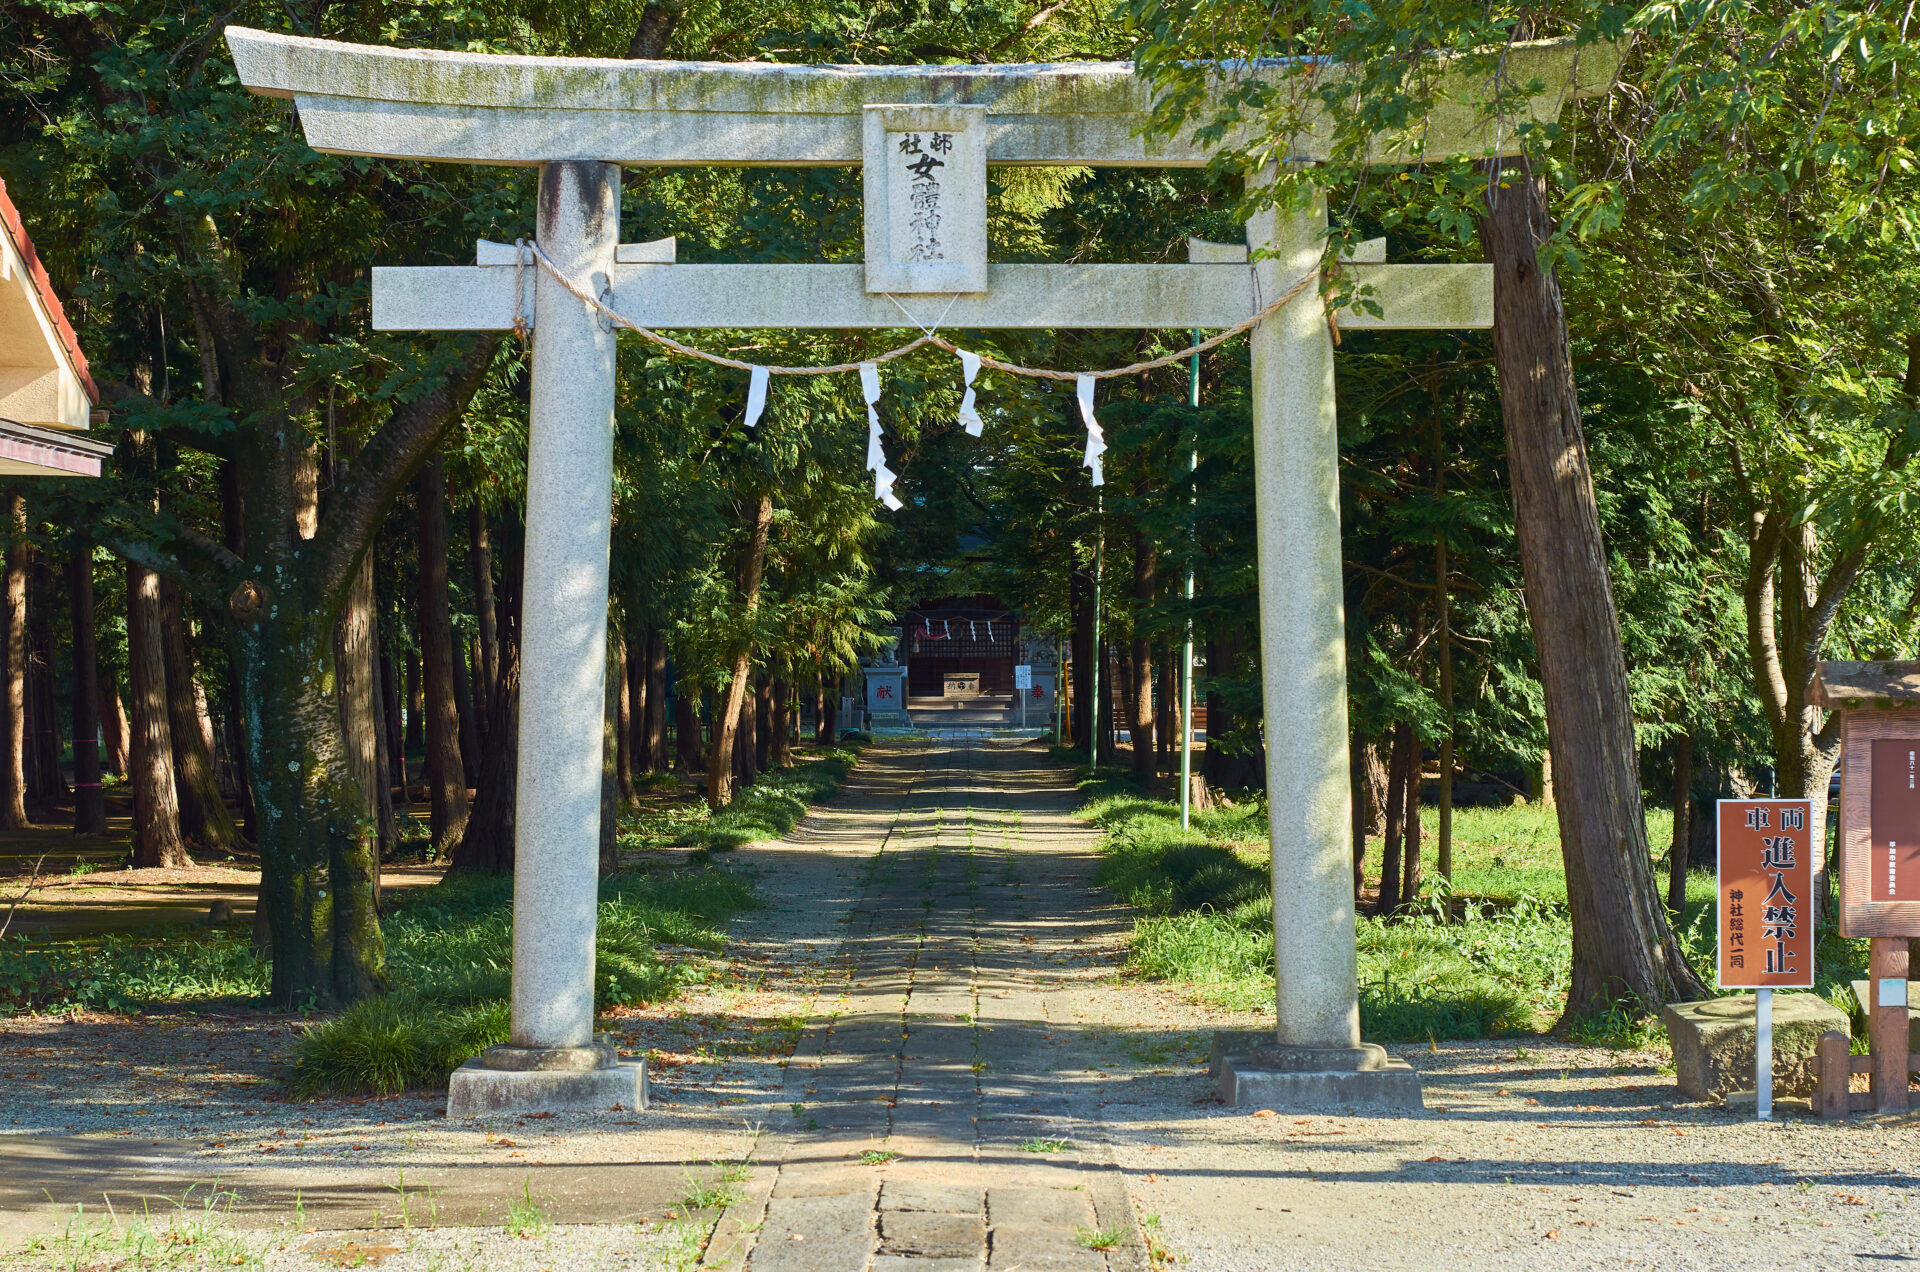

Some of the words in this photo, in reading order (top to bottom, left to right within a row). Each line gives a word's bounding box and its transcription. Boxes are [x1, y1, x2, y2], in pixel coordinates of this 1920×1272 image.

[877, 685, 892, 699] 献
[1745, 807, 1804, 830] 車両
[1730, 889, 1744, 968] 神社総代一同
[1761, 836, 1798, 973] 進入禁止
